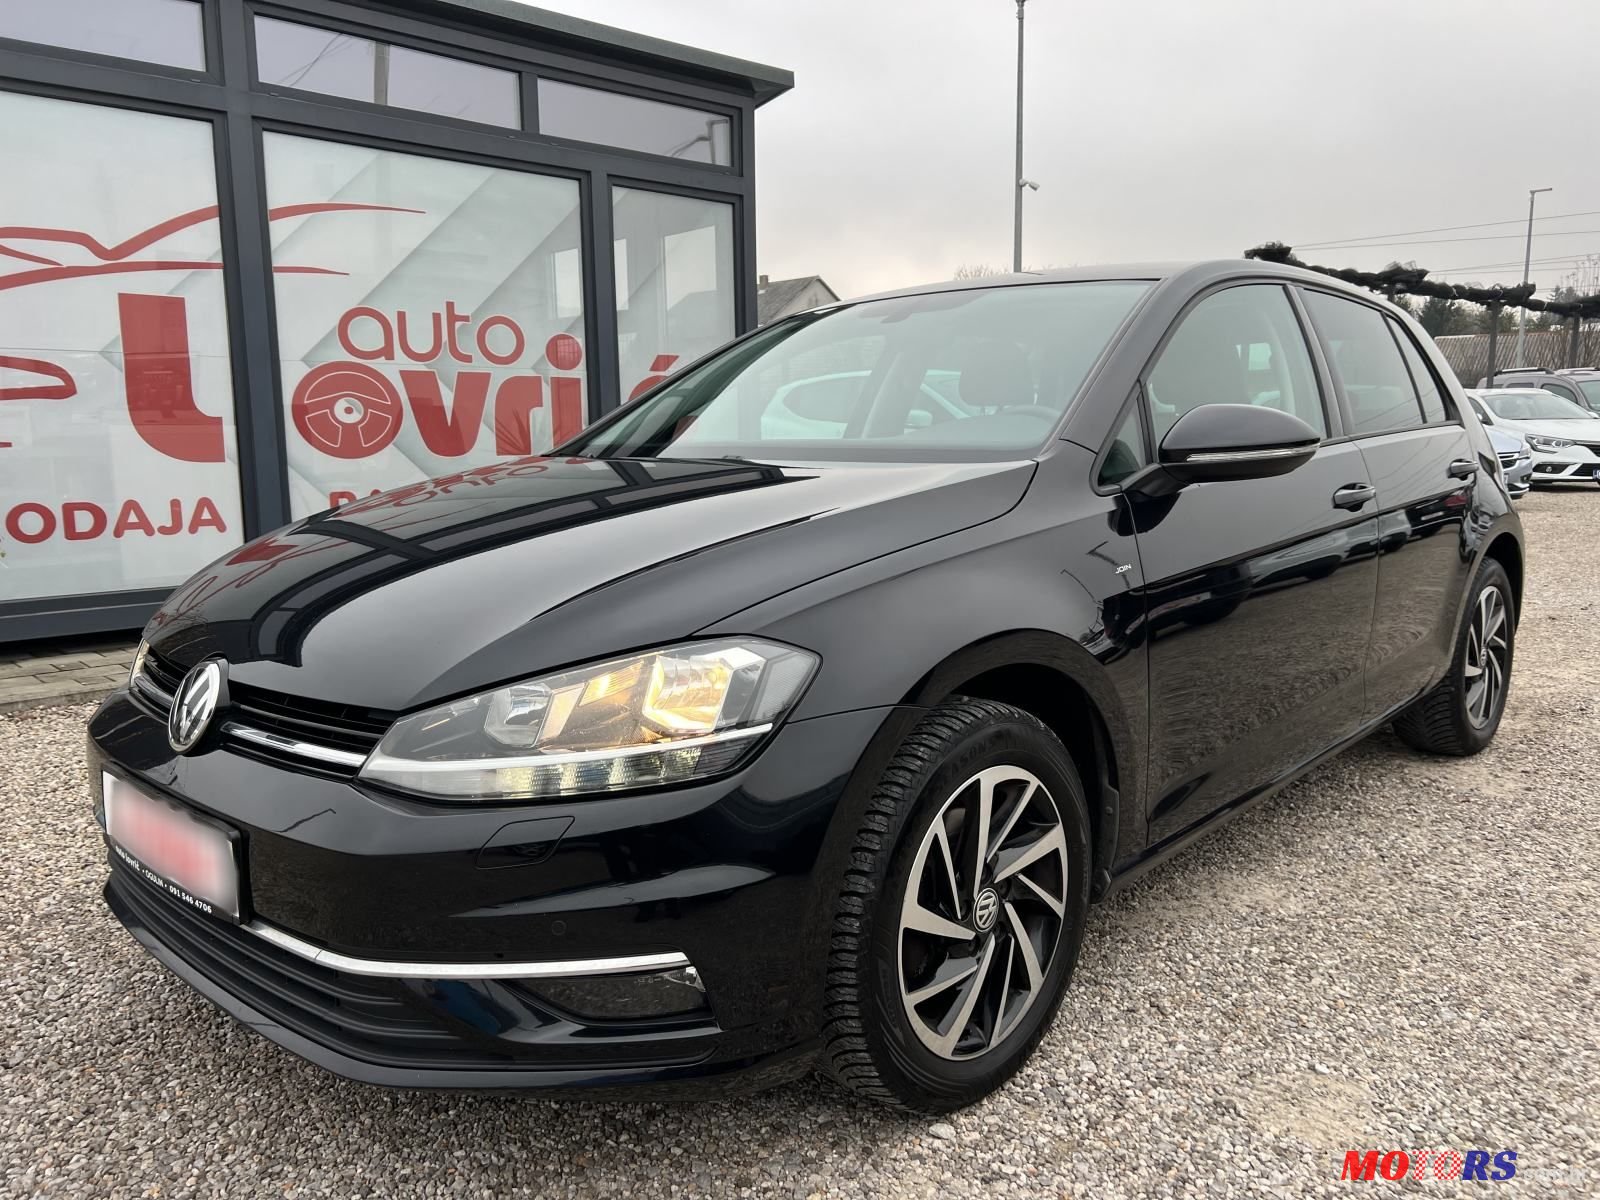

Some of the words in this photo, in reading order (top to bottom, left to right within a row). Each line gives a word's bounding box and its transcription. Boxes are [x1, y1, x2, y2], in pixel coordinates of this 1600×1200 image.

[337, 301, 526, 364] auto
[5, 496, 228, 544] ODAJA
[1115, 563, 1132, 574] JOIN
